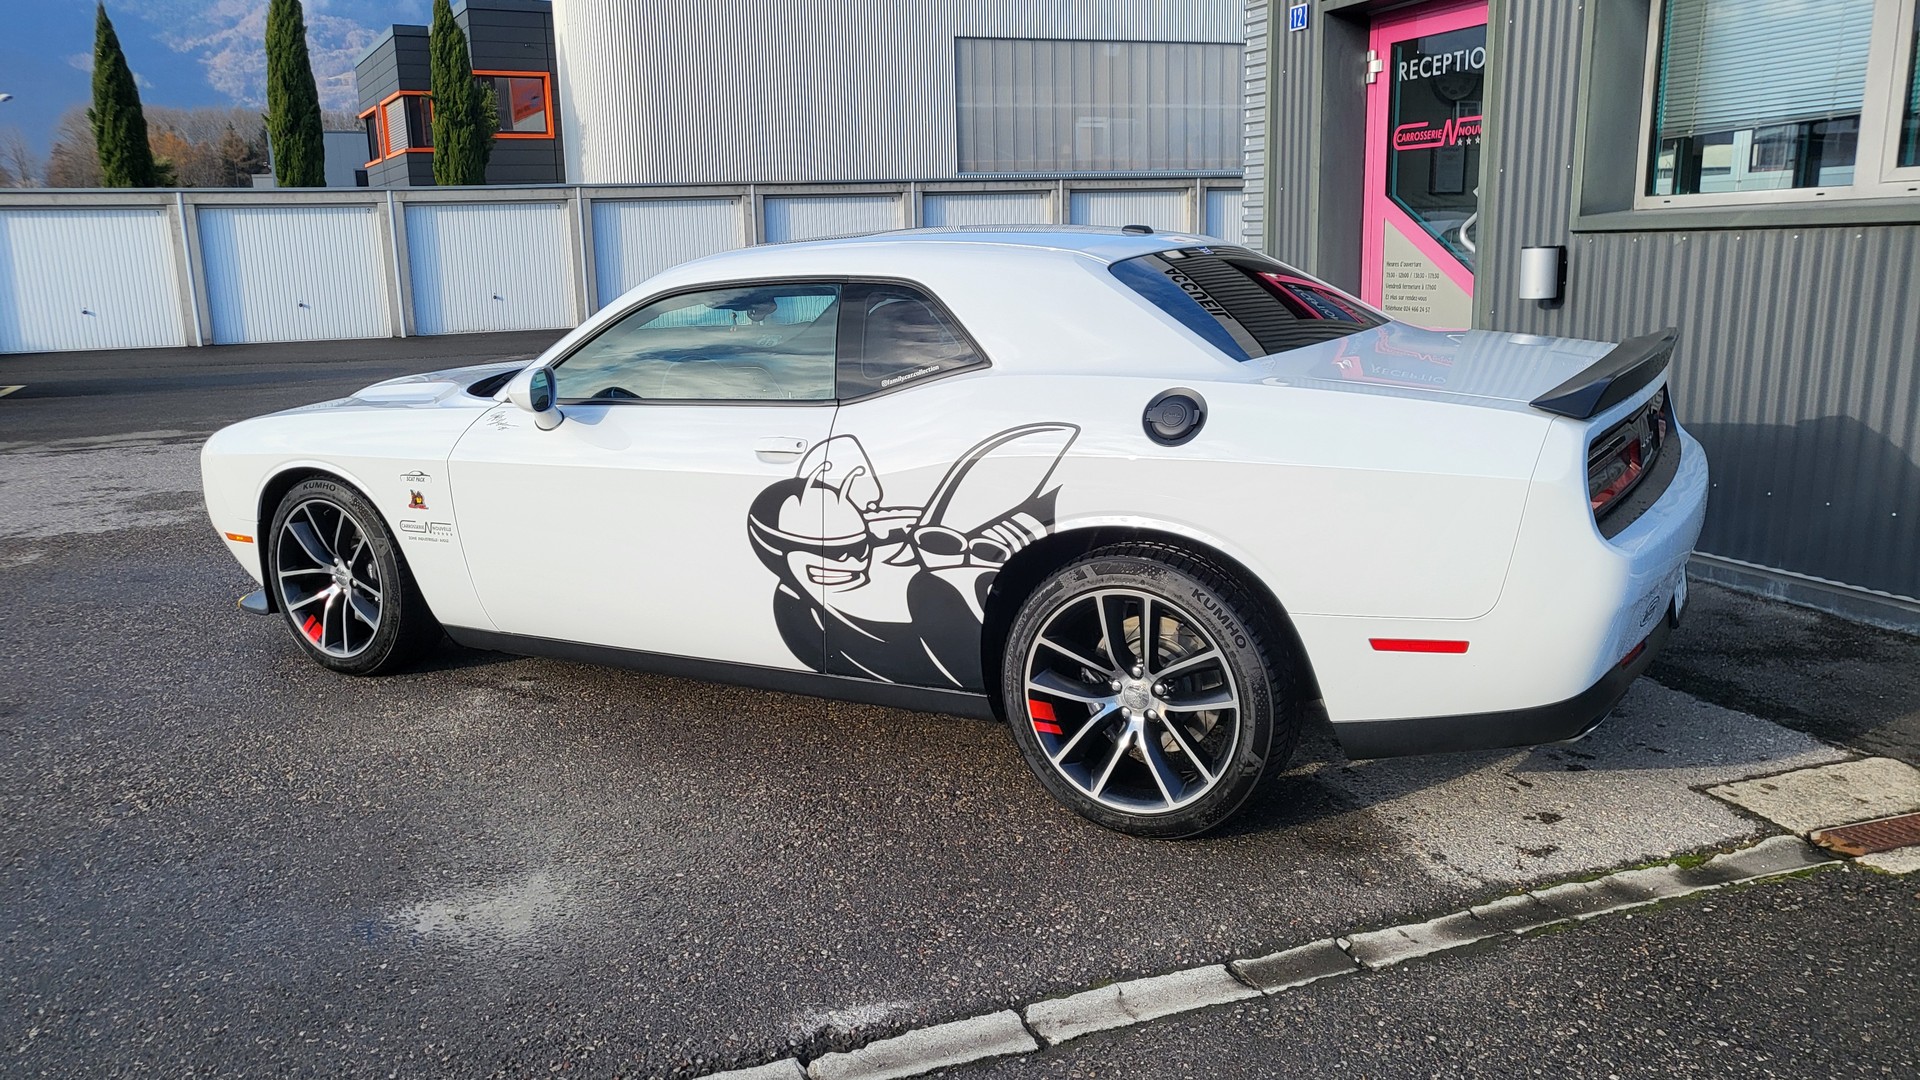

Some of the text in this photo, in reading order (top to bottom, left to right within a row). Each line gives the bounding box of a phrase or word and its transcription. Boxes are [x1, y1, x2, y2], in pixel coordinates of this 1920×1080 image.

[1293, 7, 1303, 28] 12
[1399, 46, 1486, 82] RECEPTIO
[1396, 128, 1443, 143] CARROSSERIE
[303, 482, 336, 492] KUMHO
[1191, 588, 1247, 649] KUMHO
